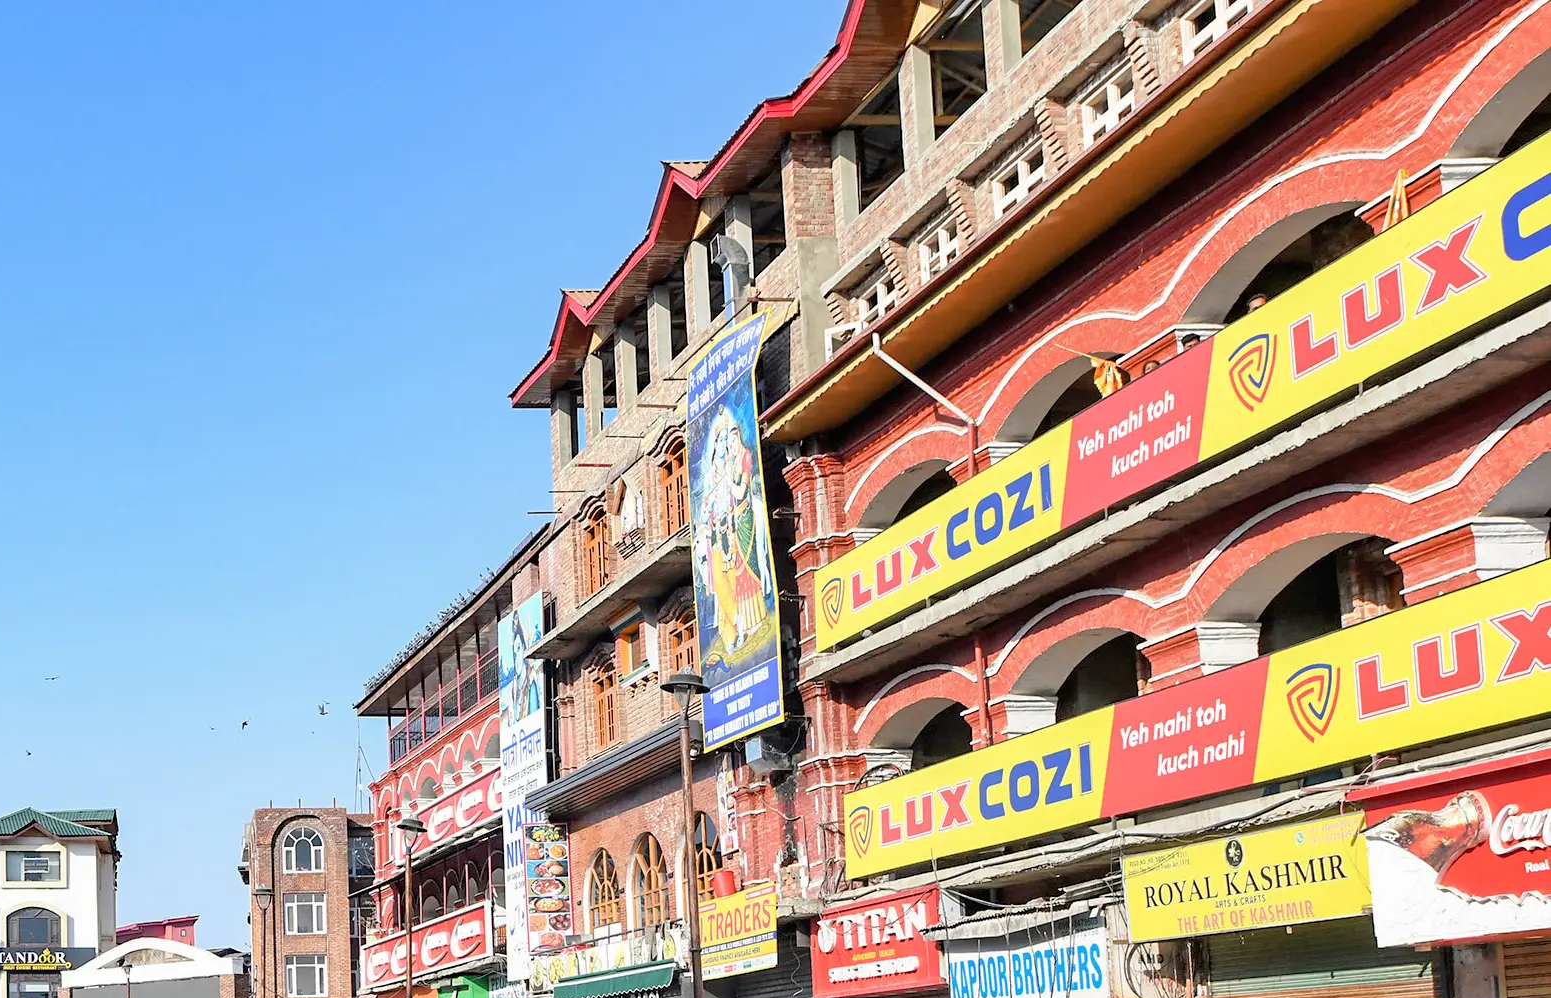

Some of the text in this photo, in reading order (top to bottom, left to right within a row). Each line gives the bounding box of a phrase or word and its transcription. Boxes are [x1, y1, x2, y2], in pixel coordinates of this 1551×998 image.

[1289, 211, 1490, 381] LUX
[1077, 390, 1175, 461] Yeh nahi toh
[1111, 415, 1192, 478] kuch nahi
[850, 460, 1053, 614] LUX COZI
[1354, 599, 1551, 720] LUX
[1120, 698, 1226, 750] Yeh nahi toh
[1157, 731, 1245, 777] kuch nahi
[879, 742, 1093, 848] LUX COZI
[1144, 876, 1219, 908] ROYAL
[1224, 854, 1348, 895] KASHMIR
[1525, 859, 1550, 873] Real
[836, 901, 927, 950] TITAN
[1177, 900, 1314, 932] THE ART OF KASHMIR
[1215, 899, 1232, 908] ARTS
[1240, 894, 1266, 905] CRAFTS
[1012, 943, 1103, 996] BROTHERS
